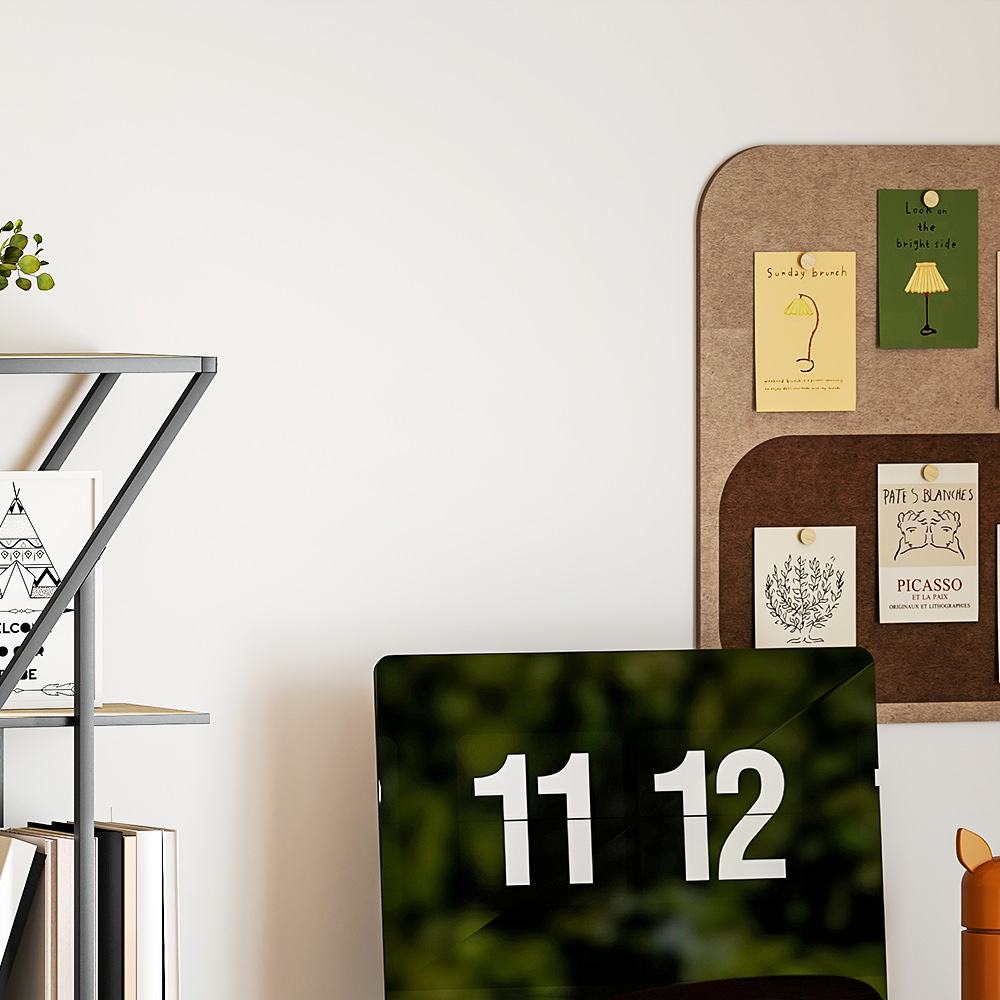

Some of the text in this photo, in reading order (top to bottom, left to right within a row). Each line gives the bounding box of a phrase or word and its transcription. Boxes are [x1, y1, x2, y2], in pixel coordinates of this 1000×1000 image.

[905, 202, 932, 214] Look
[918, 221, 936, 231] the
[896, 238, 957, 251] bright side
[767, 266, 847, 280] Sunday brunch
[897, 578, 963, 592] PICASSO
[474, 748, 786, 886] 11 12
